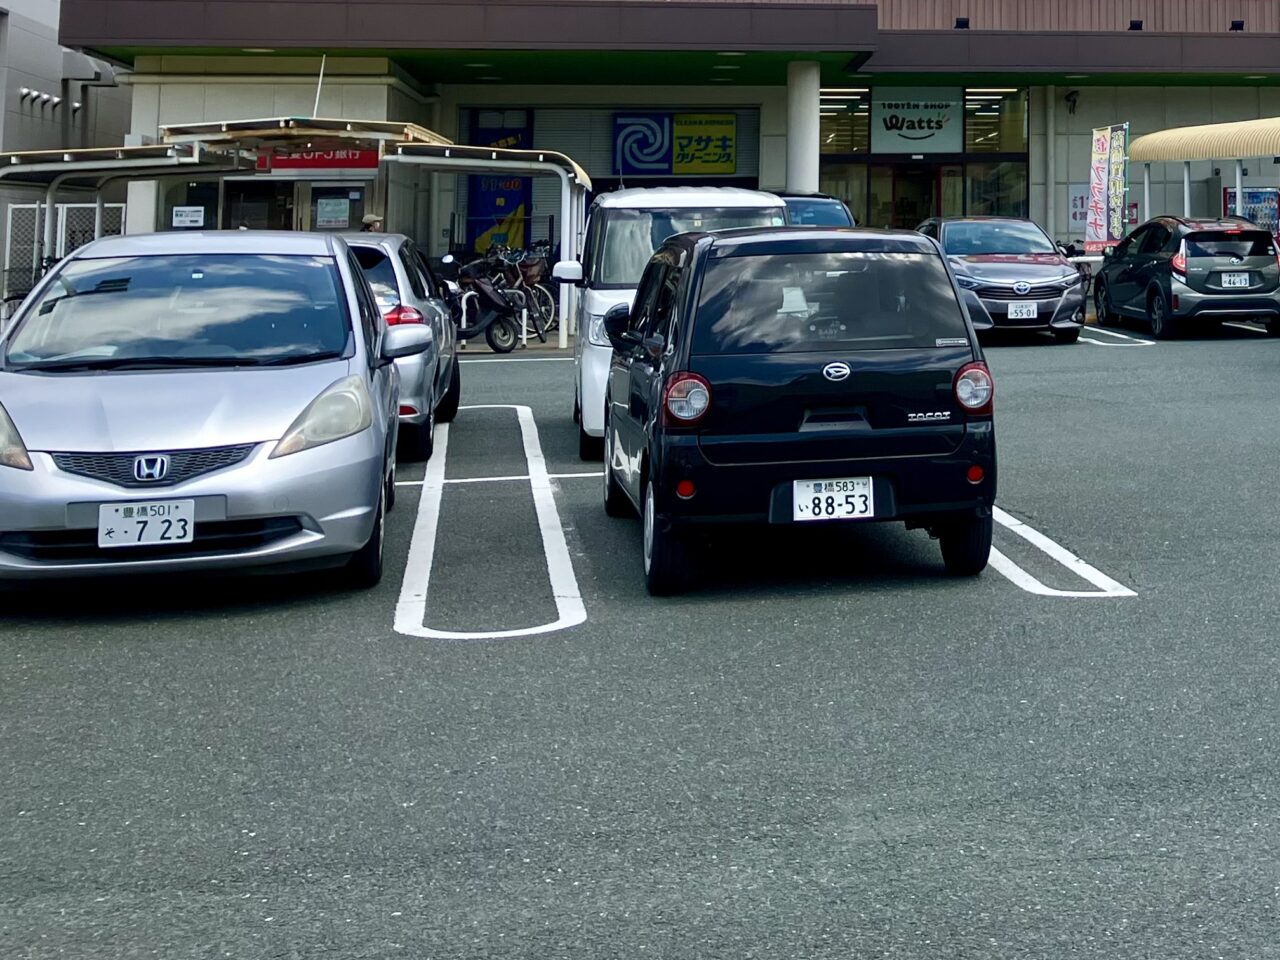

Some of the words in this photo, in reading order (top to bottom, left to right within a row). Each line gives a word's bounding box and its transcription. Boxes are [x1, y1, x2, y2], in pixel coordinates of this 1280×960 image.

[882, 114, 944, 131] Watts
[675, 135, 734, 152] マサキ
[812, 494, 869, 517] 88-53
